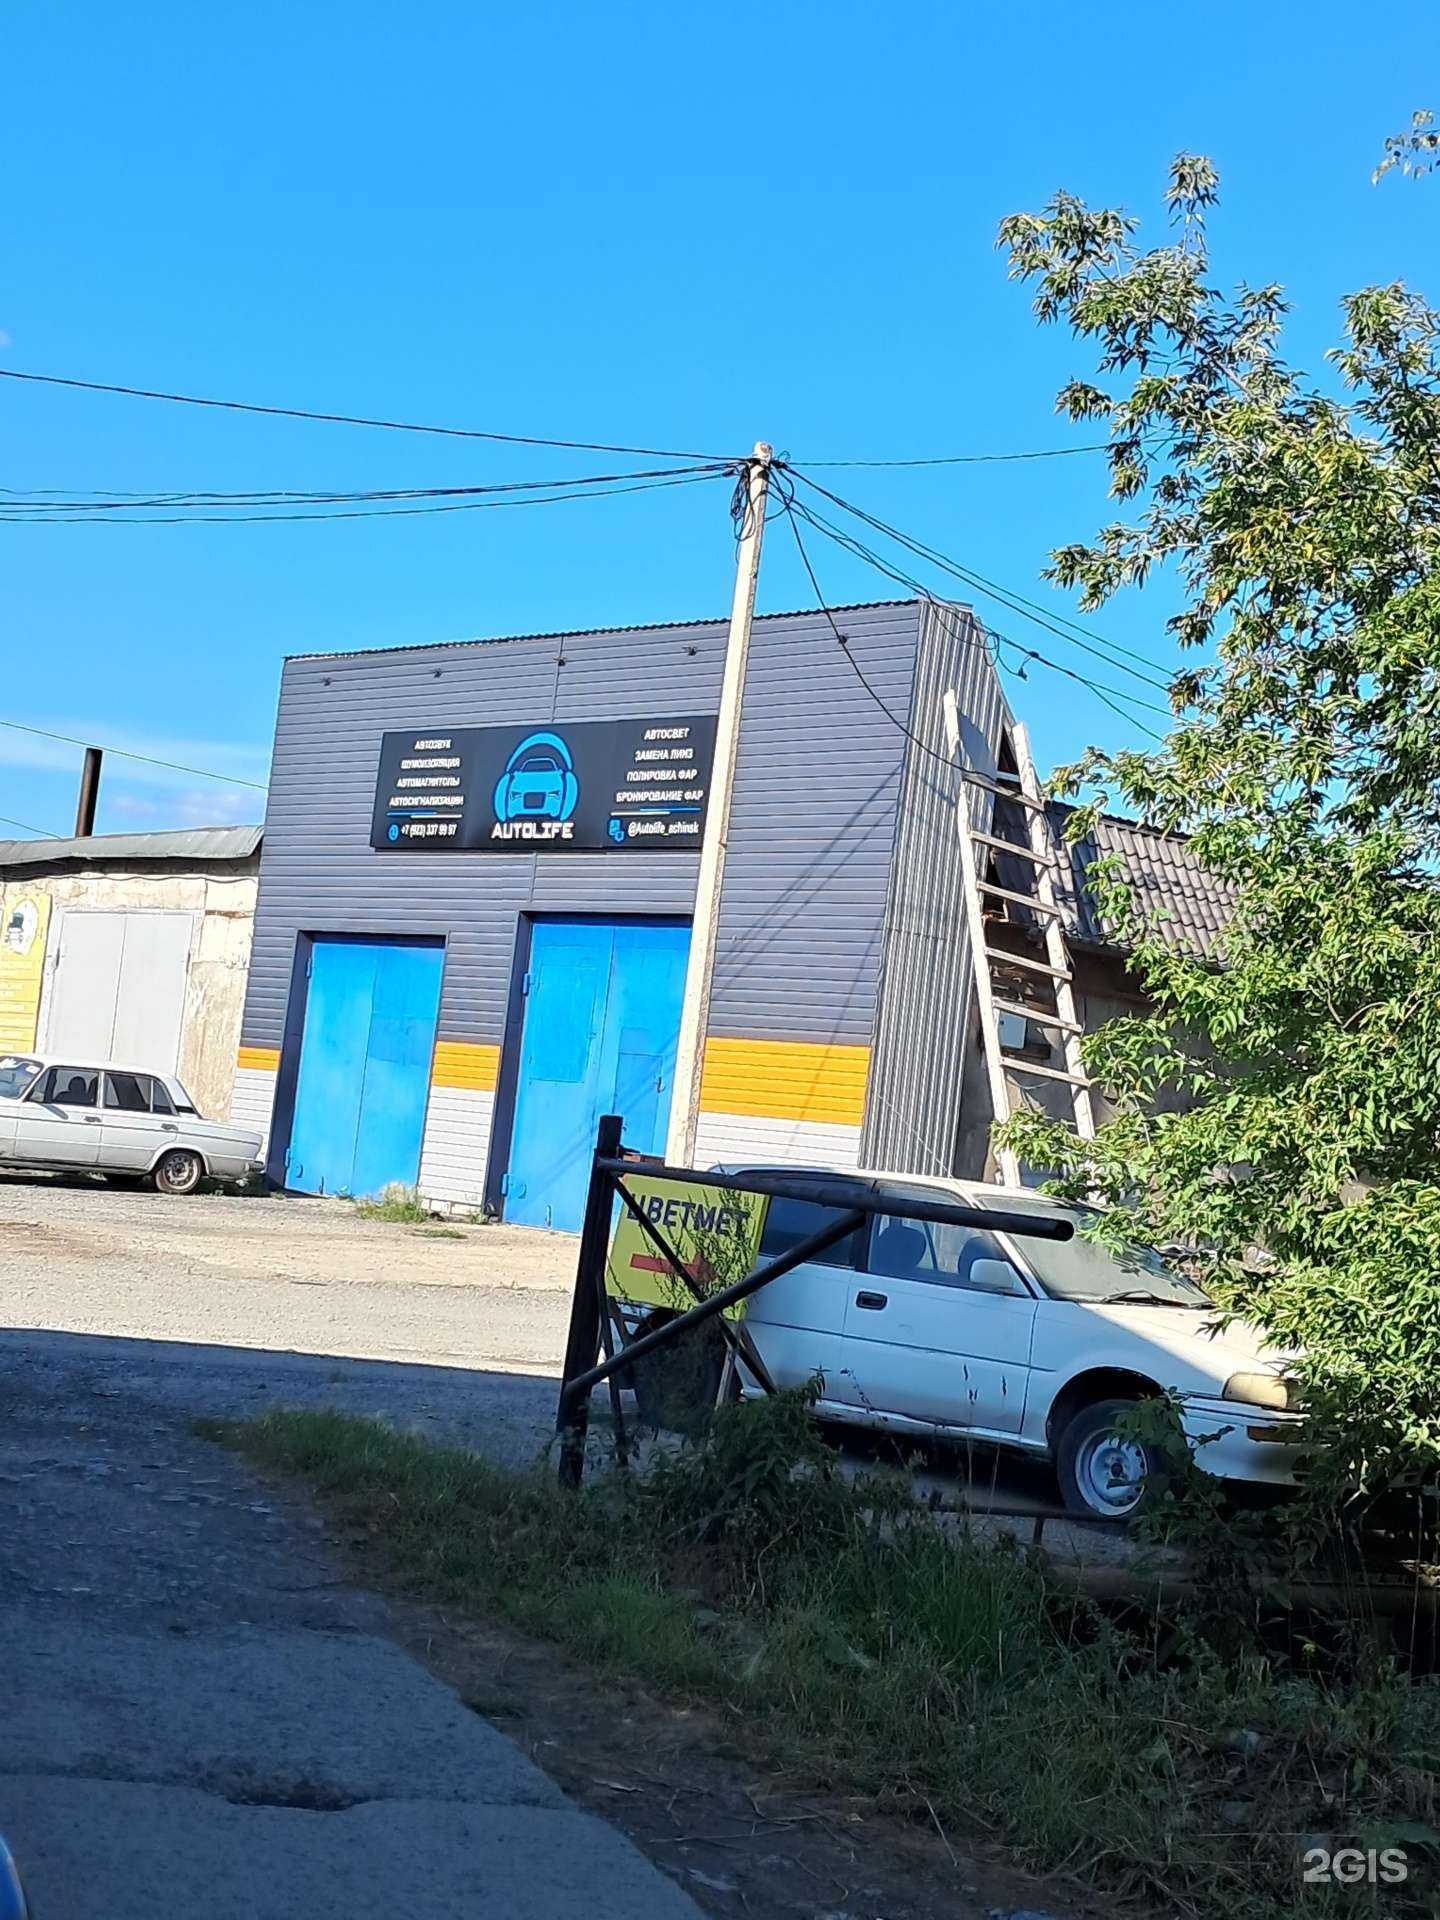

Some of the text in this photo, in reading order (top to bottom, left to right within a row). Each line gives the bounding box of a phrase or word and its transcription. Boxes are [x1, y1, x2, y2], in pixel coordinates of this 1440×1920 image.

[644, 728, 690, 741] АВТОСВЕТ
[635, 748, 694, 762] ЗАМЕНА ЛИНЗ
[626, 769, 698, 782] ПОЛИРОВКА ФАР
[396, 777, 461, 788] АВТОМАГНИТОЛЫ
[616, 790, 704, 802] БРОНИРОВАНИЕ ФАР
[491, 822, 574, 839] AUTOLIFE
